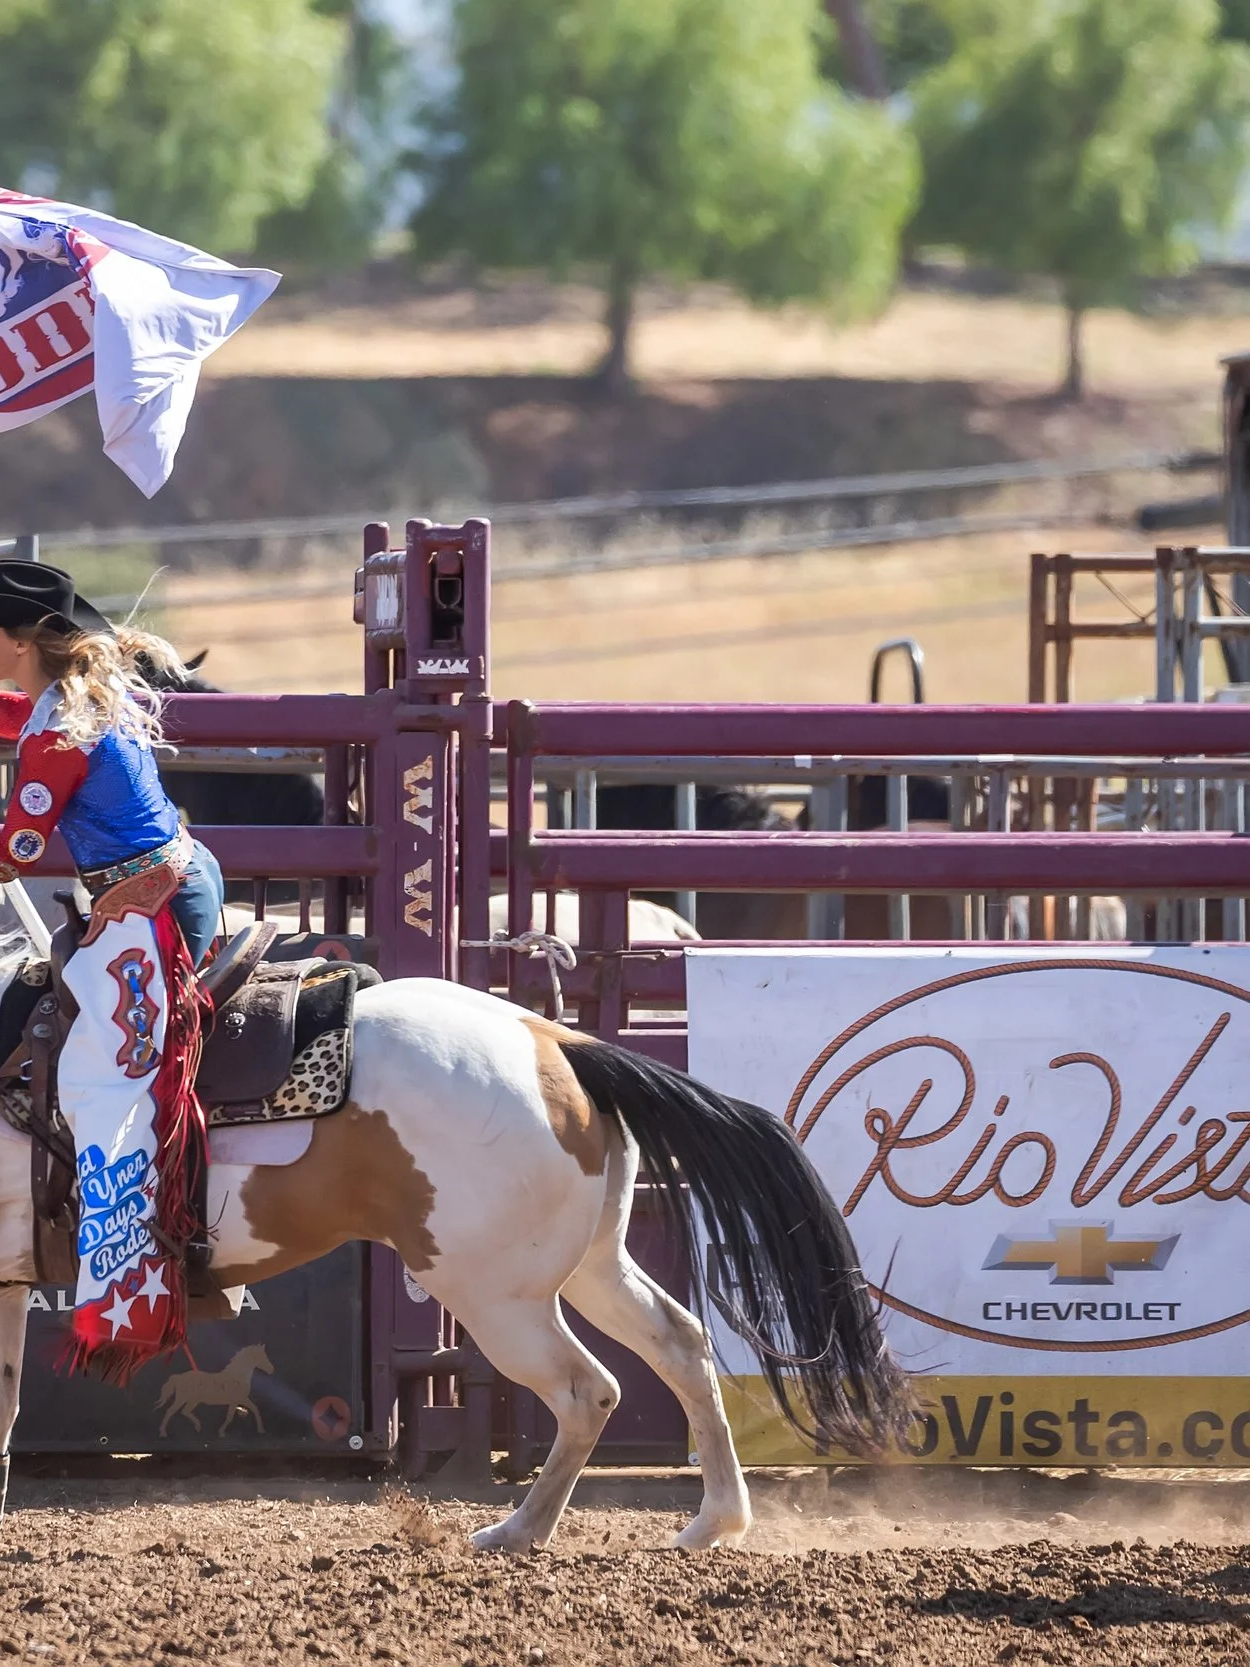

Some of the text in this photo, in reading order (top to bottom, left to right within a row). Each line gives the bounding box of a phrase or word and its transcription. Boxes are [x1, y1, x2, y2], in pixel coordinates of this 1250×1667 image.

[797, 1036, 1057, 1217] Rio
[78, 1199, 138, 1250] Days
[982, 1302, 1182, 1321] CHEVROLET
